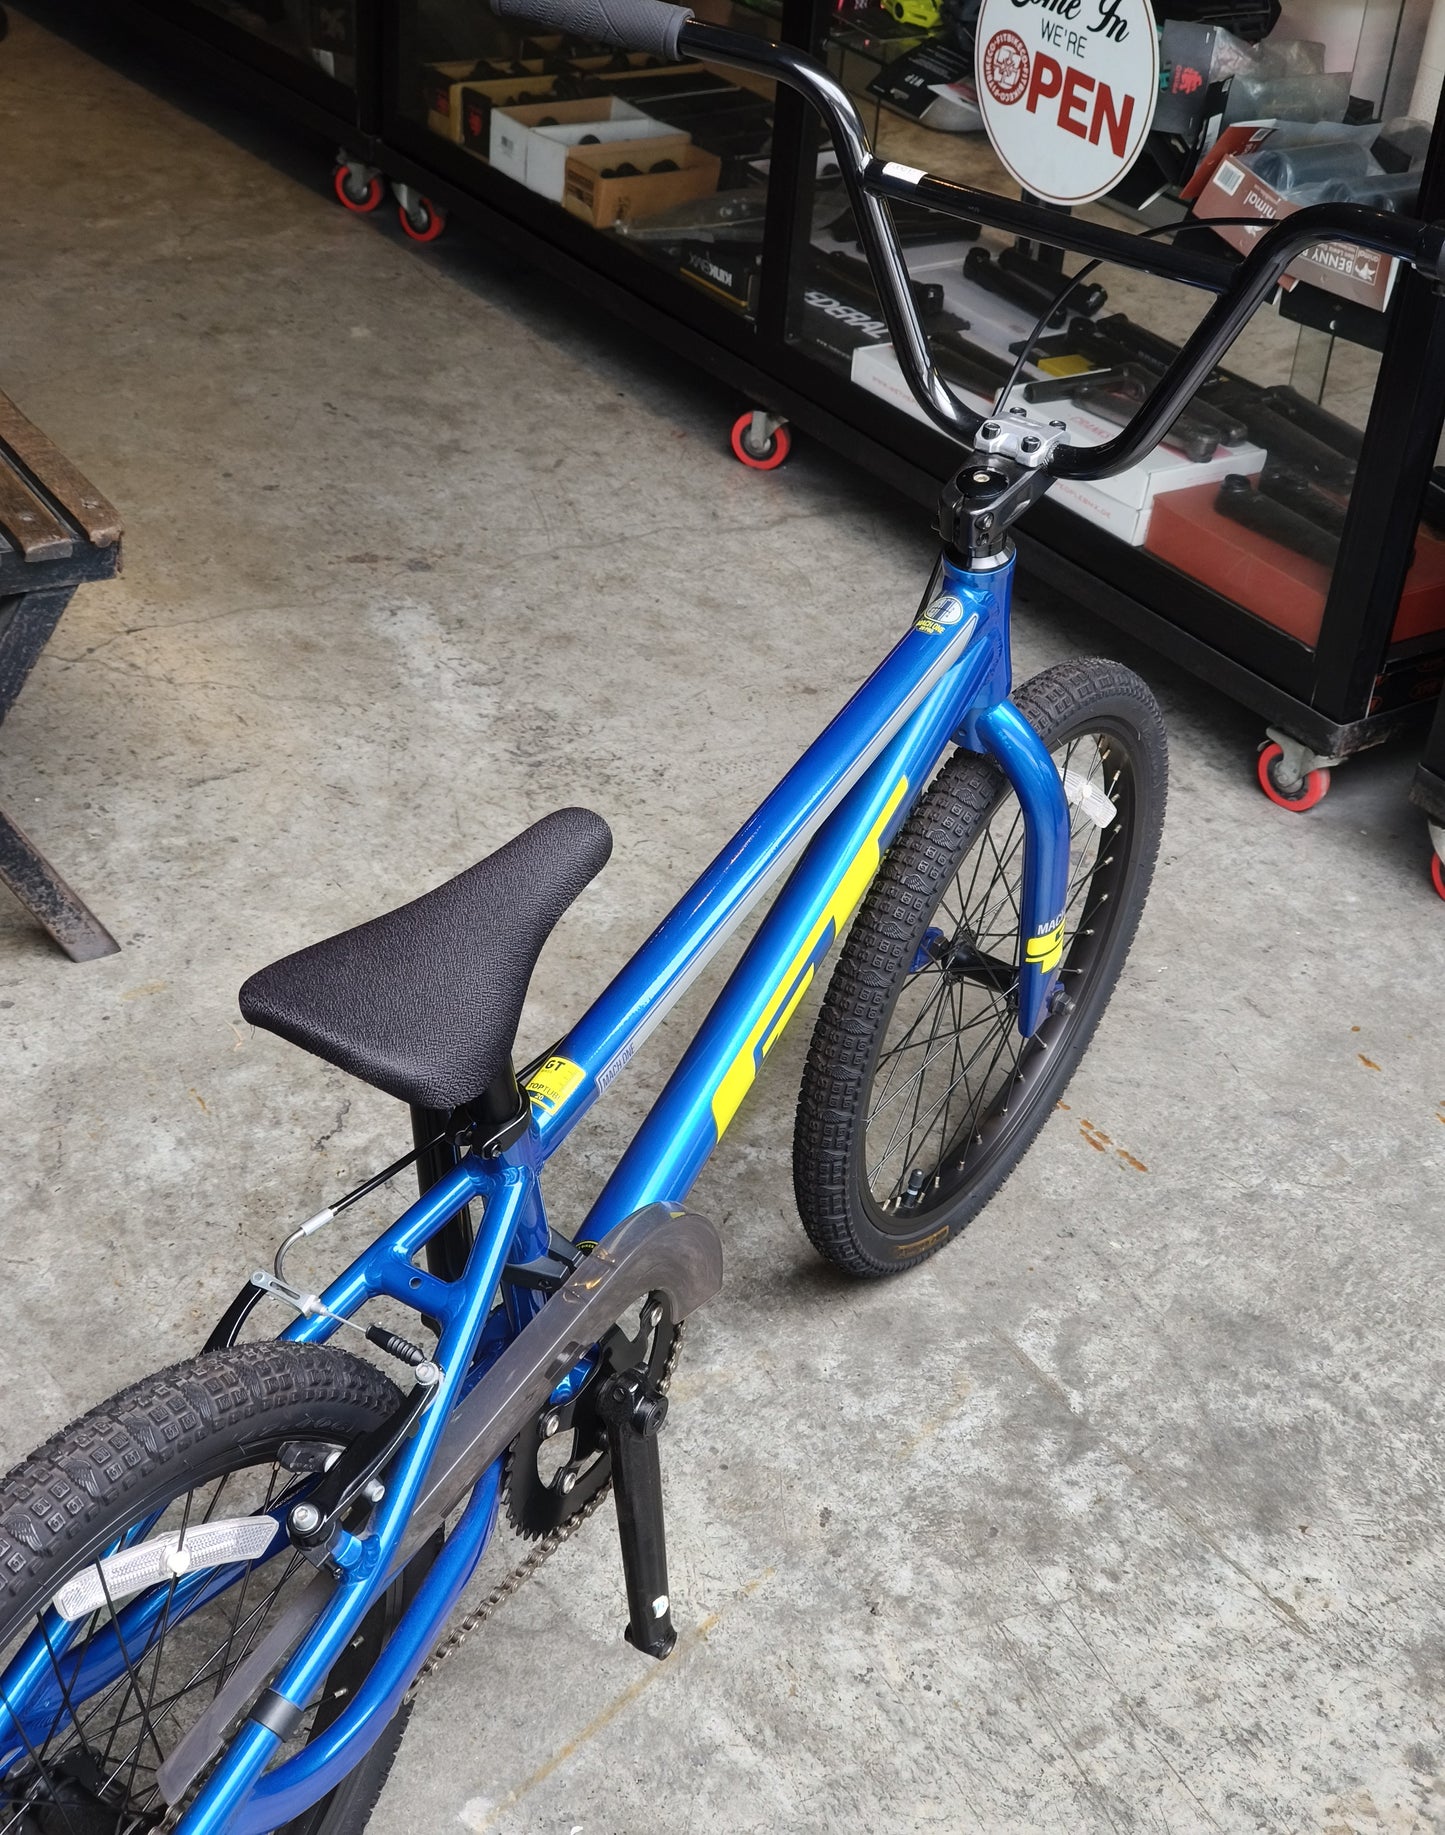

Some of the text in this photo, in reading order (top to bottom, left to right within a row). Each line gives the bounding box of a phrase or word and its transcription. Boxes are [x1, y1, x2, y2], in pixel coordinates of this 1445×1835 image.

[1041, 18, 1088, 59] WE'RE
[1243, 190, 1277, 219] nimal
[1311, 247, 1353, 274] BENNY
[804, 290, 889, 339] EDERAL
[545, 1059, 566, 1072] GT
[601, 1041, 636, 1090] MACH ONE
